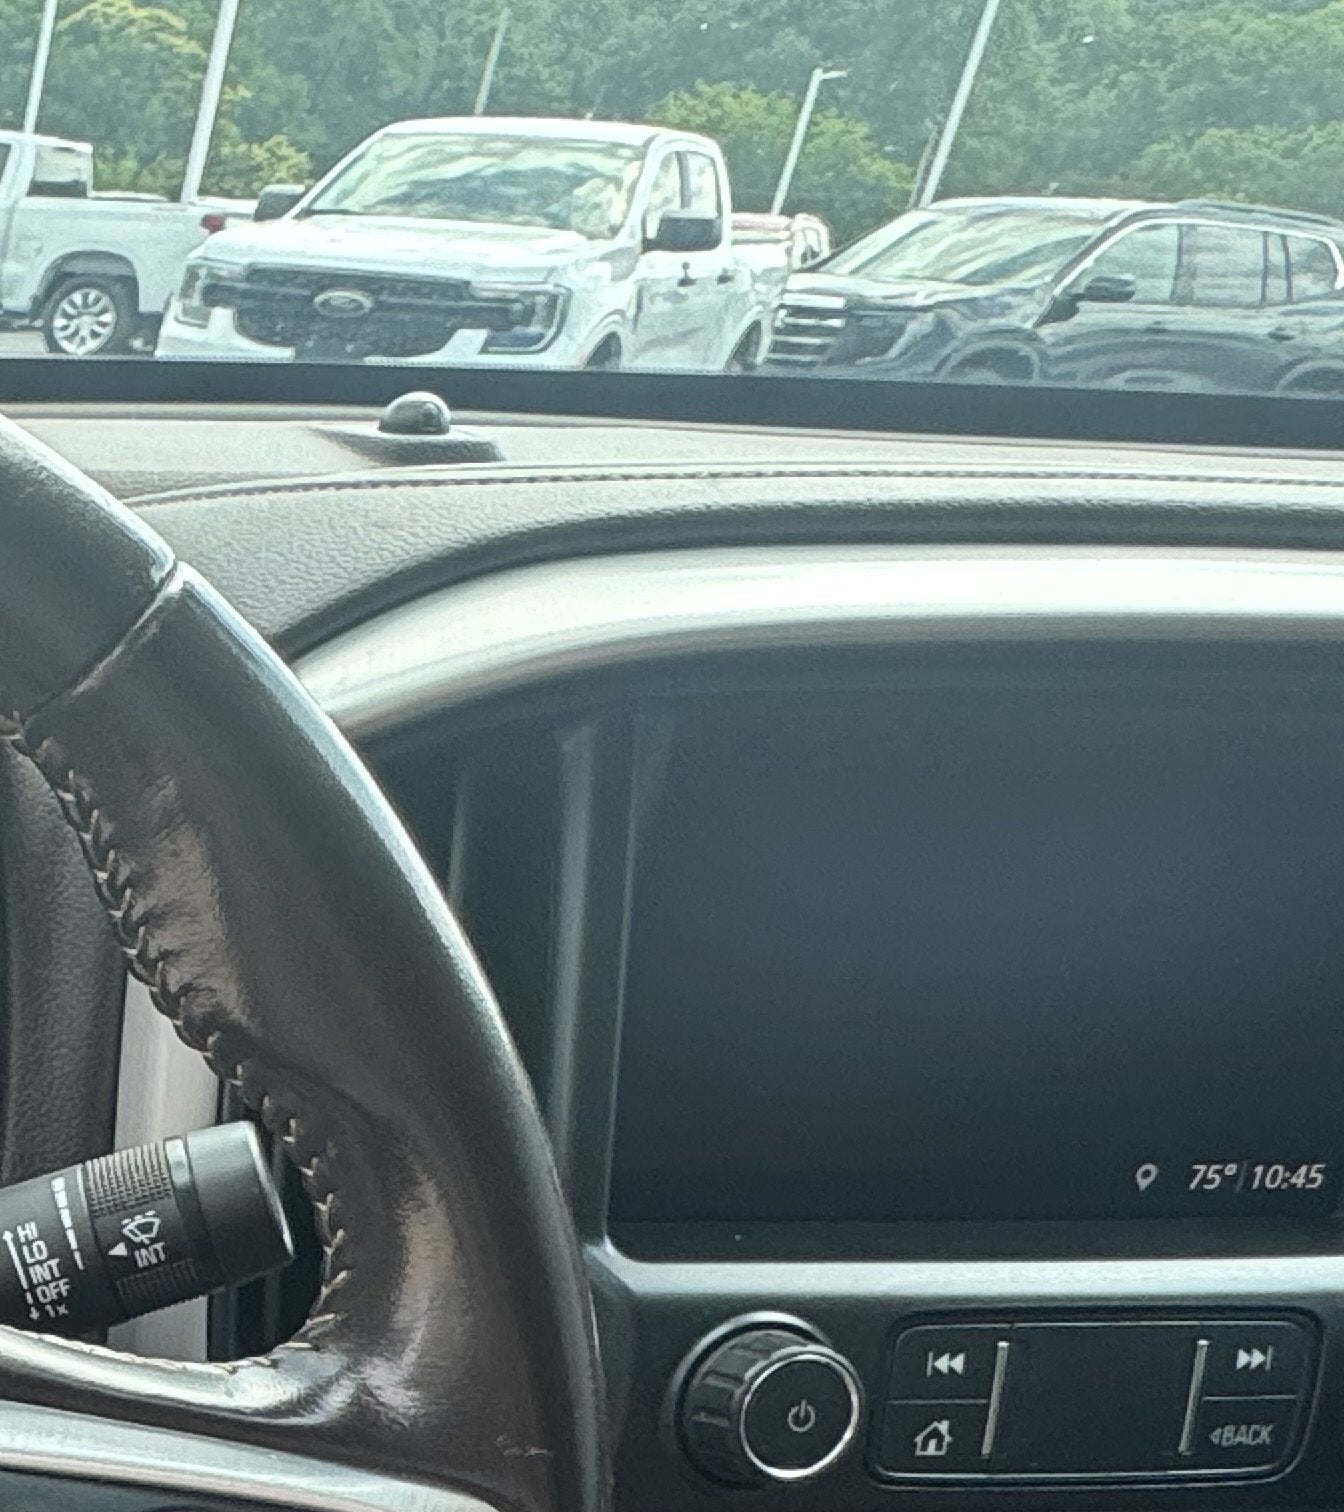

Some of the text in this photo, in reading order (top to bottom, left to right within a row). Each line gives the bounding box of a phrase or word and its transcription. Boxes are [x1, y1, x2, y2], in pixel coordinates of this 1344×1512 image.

[1188, 1163, 1326, 1191] 75° 10:45
[16, 1222, 38, 1243] HI
[23, 1241, 49, 1264] LO
[134, 1242, 167, 1269] INT
[29, 1260, 64, 1285] INT
[36, 1280, 72, 1304] OFF
[1223, 1424, 1274, 1448] BACK
